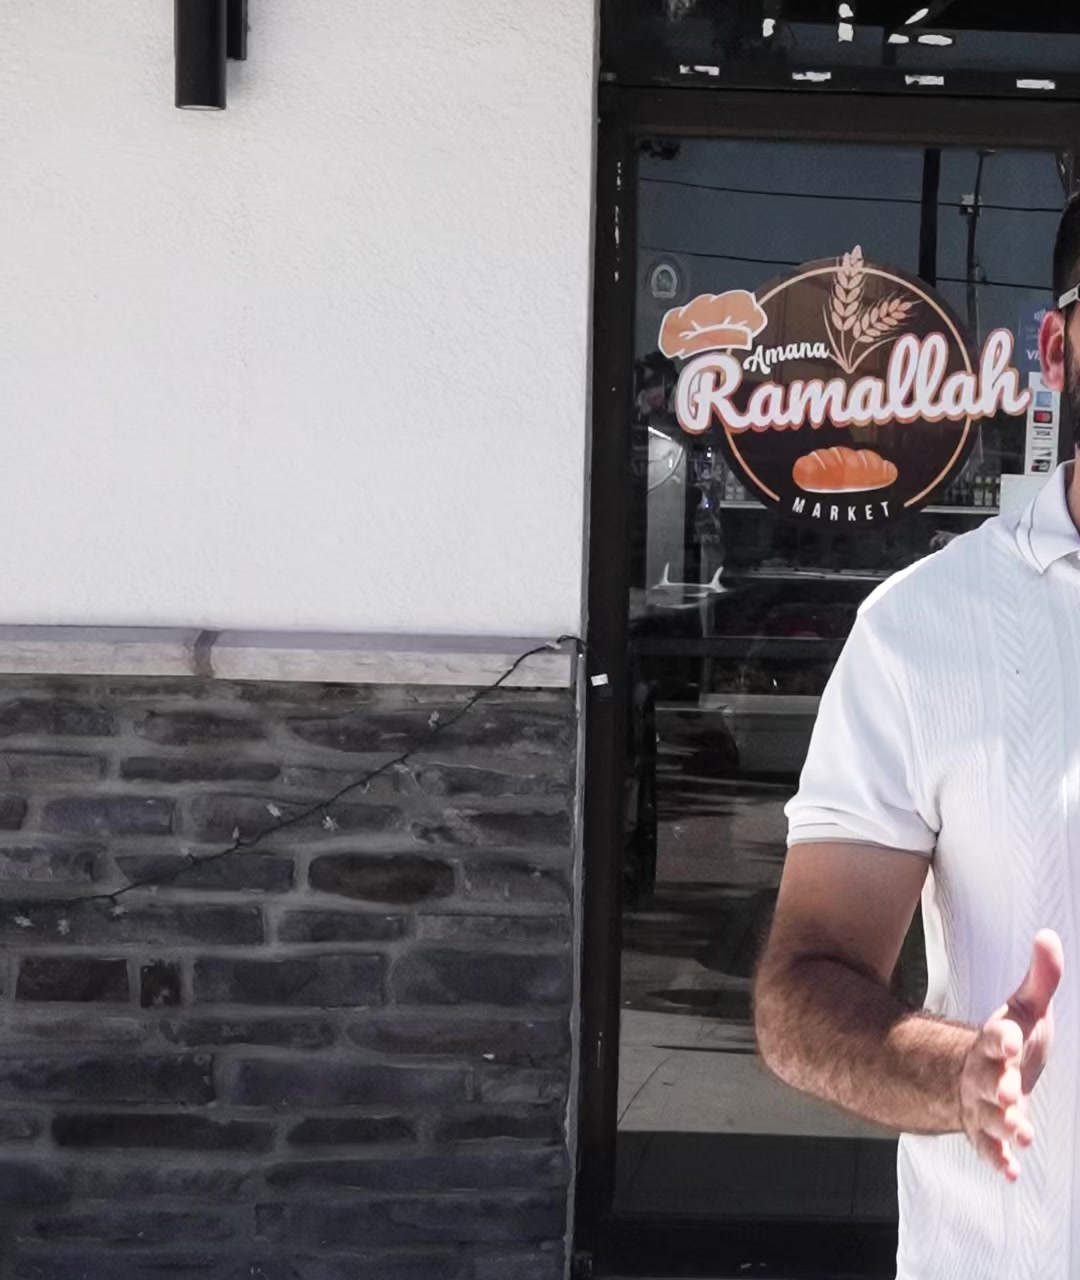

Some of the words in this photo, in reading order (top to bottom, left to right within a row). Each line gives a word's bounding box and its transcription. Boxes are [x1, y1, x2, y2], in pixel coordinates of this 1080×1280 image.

[742, 341, 830, 375] Amana
[677, 328, 1031, 431] Ramallah
[792, 496, 889, 521] MARKET
